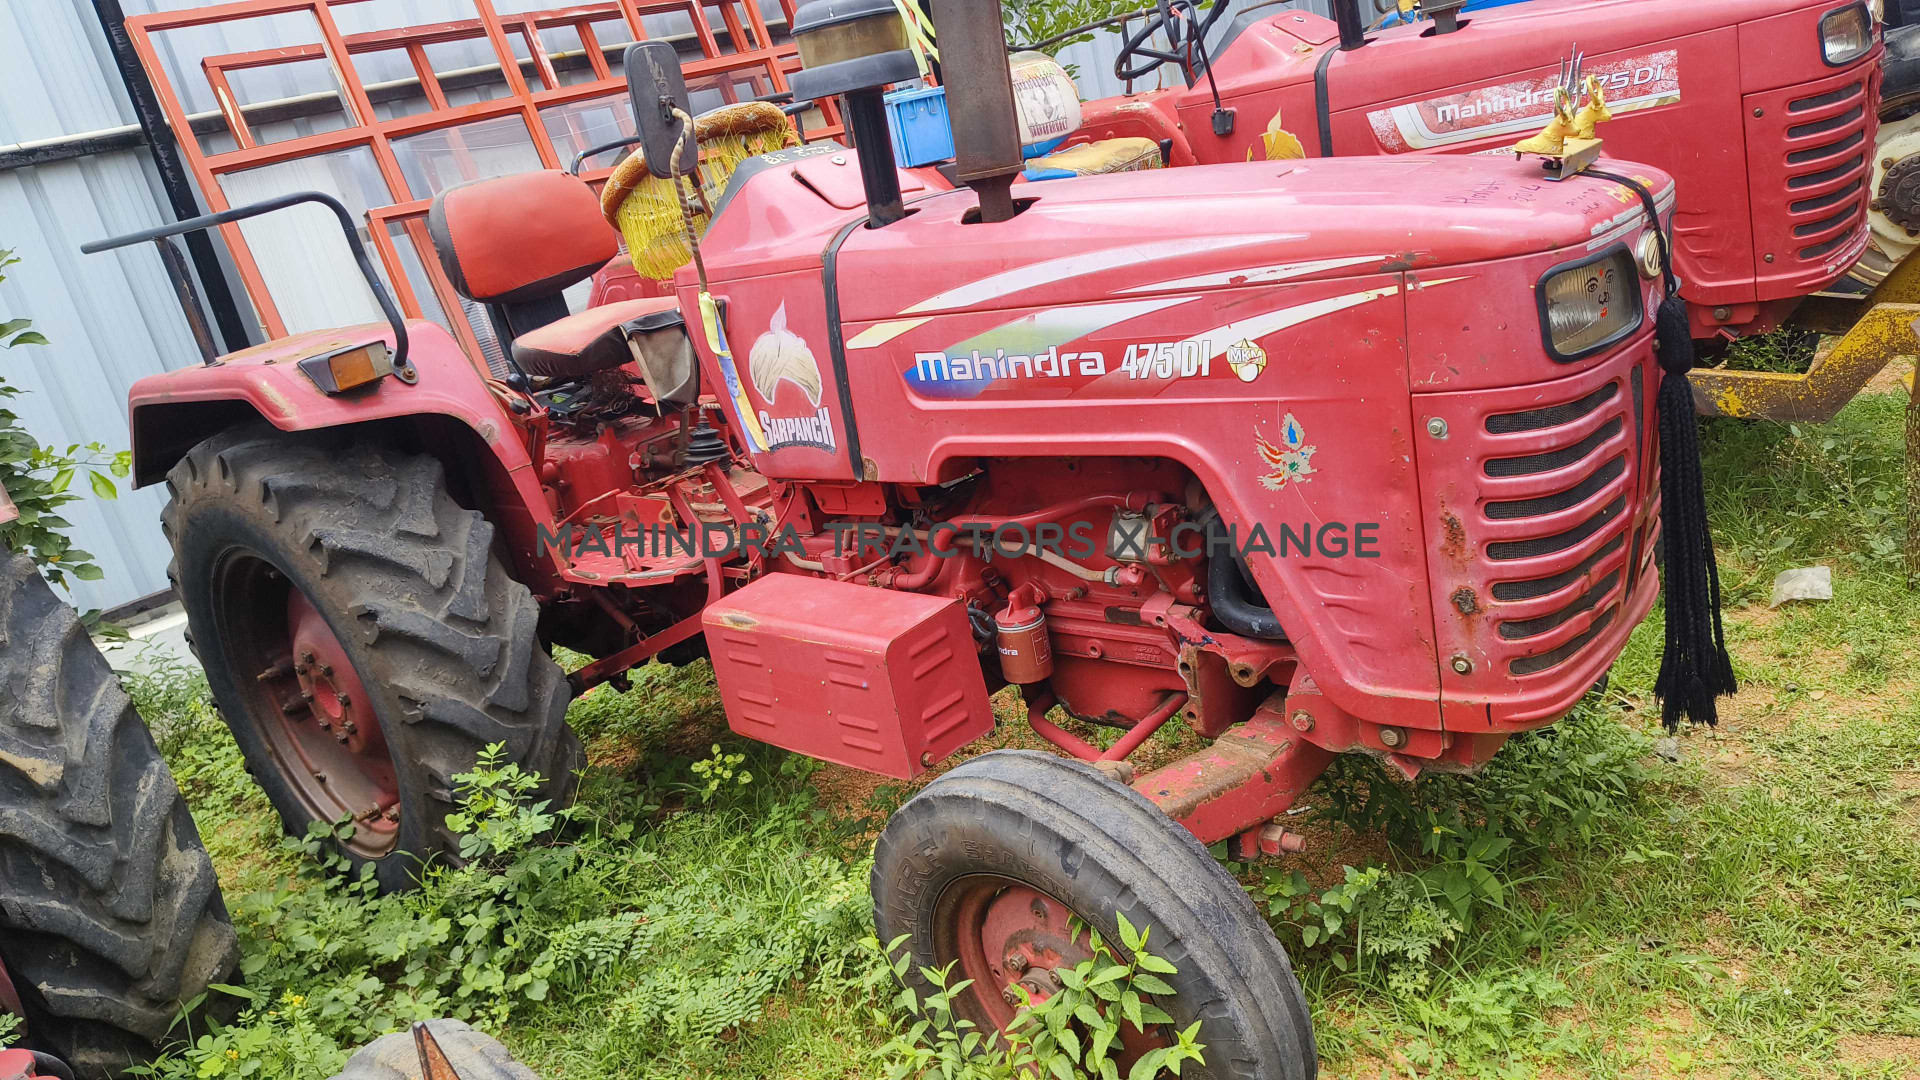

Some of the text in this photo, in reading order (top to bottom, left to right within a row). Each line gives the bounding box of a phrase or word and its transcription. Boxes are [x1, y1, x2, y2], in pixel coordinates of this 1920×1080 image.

[1633, 63, 1663, 86] DI
[914, 345, 1106, 381] Mahindra
[1229, 346, 1264, 365] MKM
